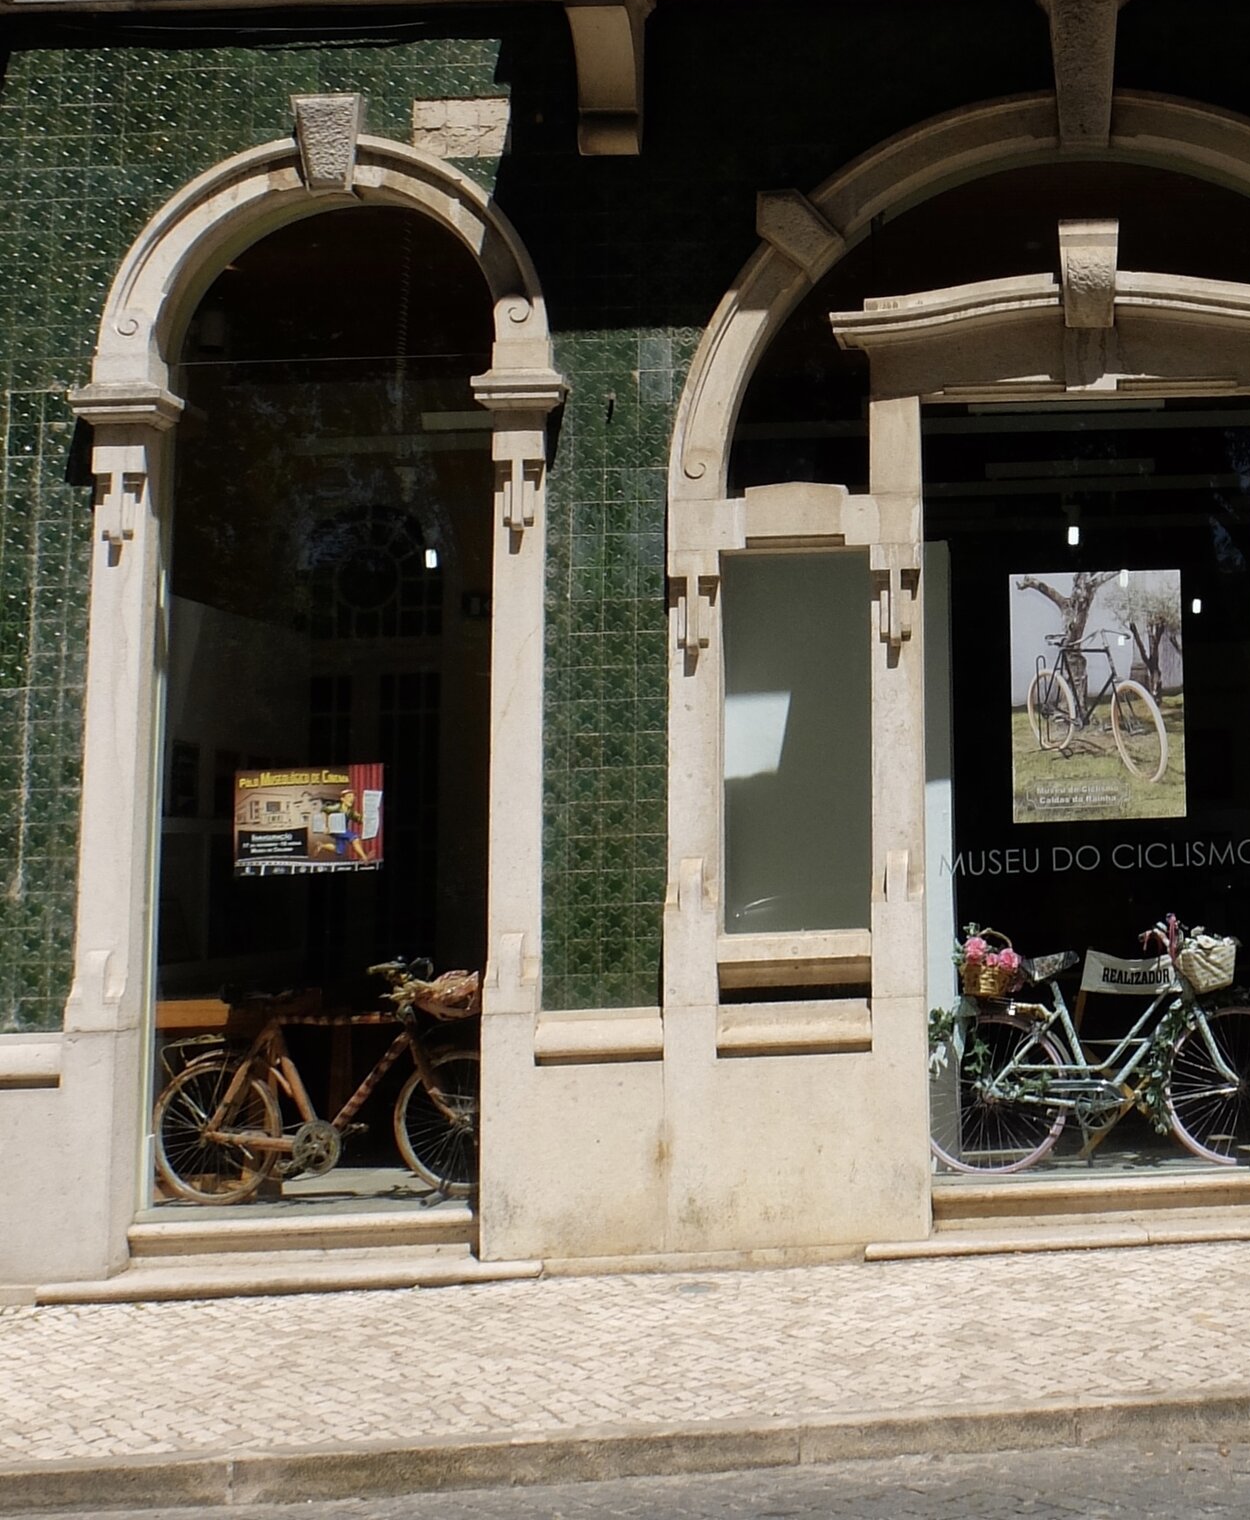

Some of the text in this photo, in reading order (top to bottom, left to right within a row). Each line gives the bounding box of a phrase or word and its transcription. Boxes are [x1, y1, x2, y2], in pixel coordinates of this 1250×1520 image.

[939, 848, 1040, 877] MUSEU
[1052, 845, 1100, 871] DO
[1102, 967, 1170, 986] REALIZADOR
